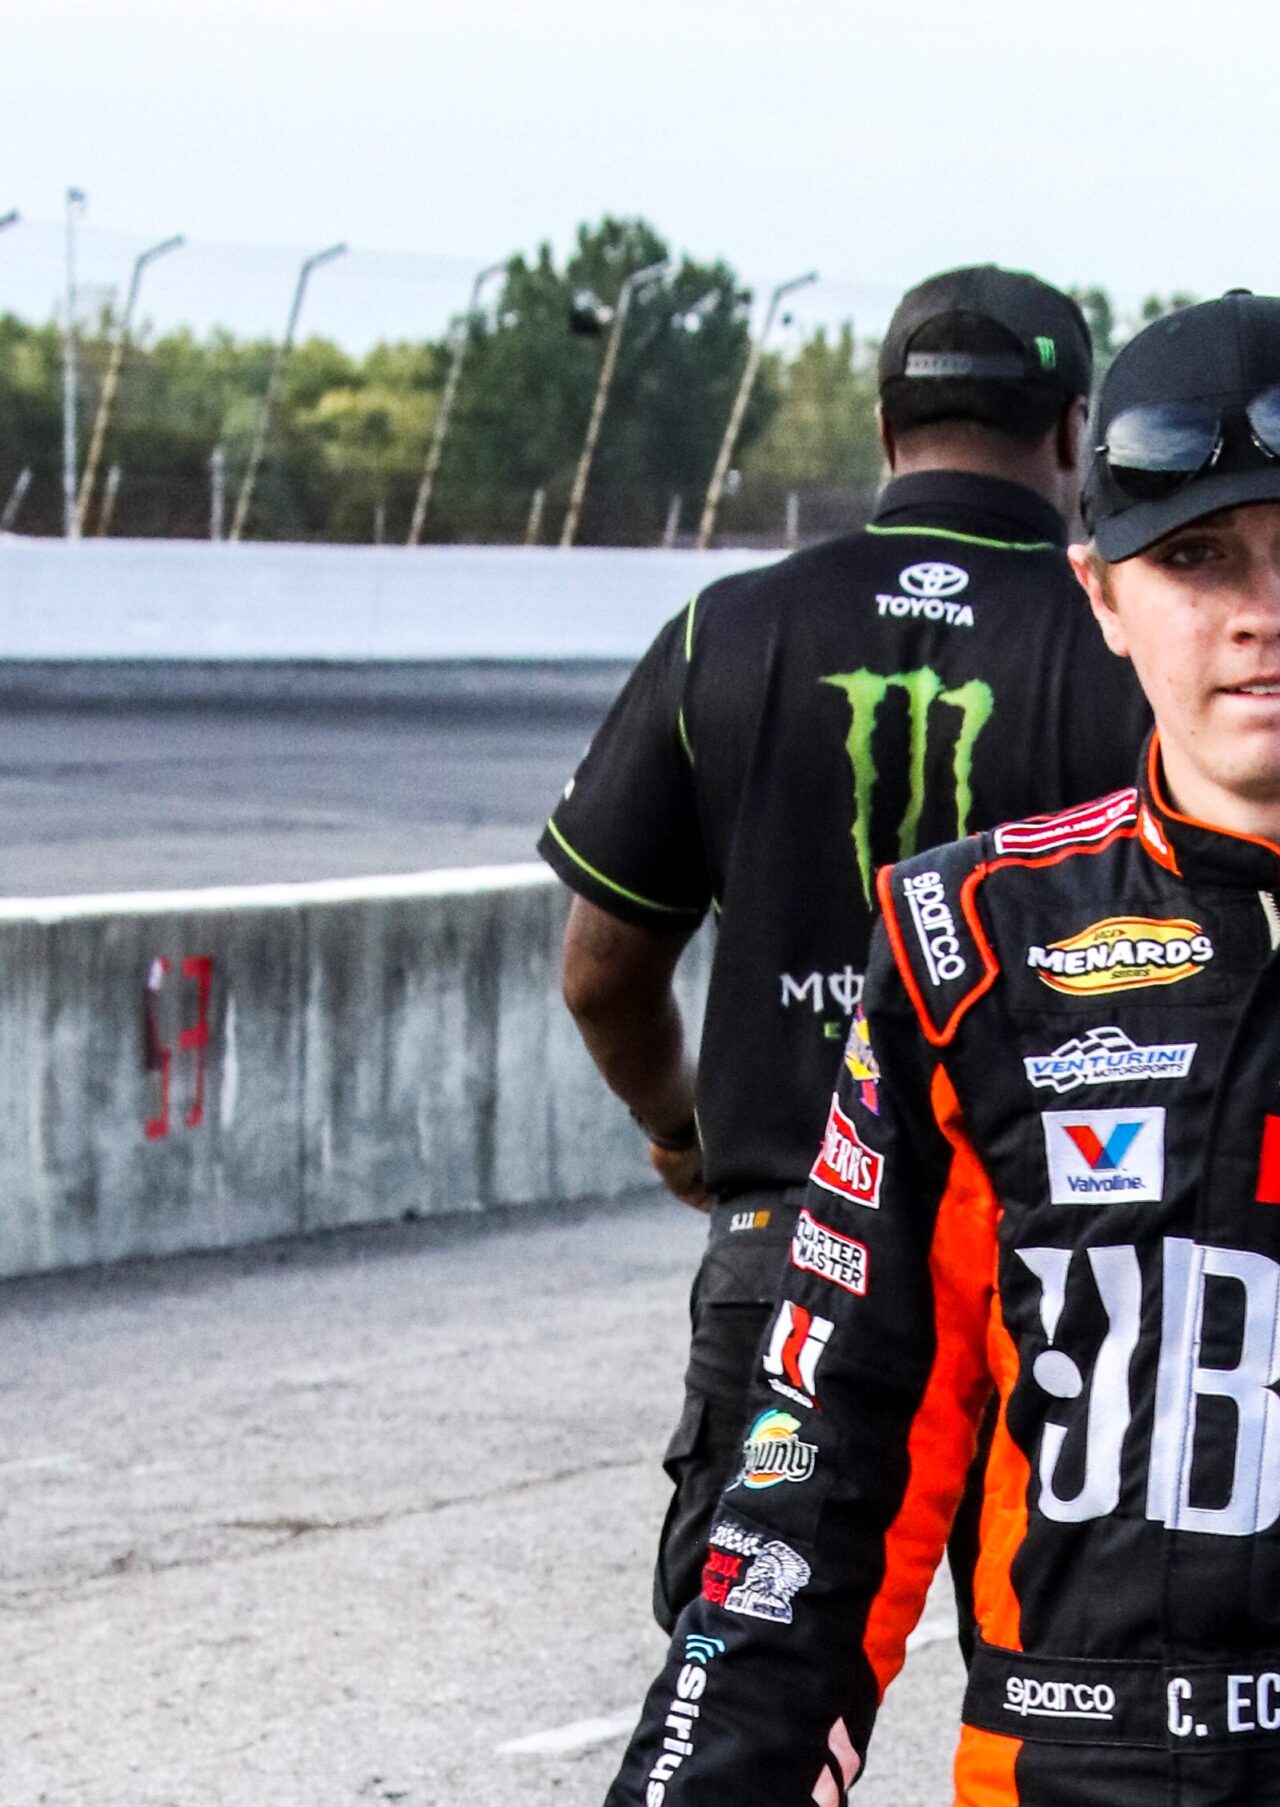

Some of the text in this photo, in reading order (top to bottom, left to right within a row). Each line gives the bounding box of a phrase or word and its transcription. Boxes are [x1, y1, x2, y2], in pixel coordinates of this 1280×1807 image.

[876, 594, 974, 626] TOYOTA
[904, 871, 967, 984] sparco
[1027, 935, 1214, 976] MENARDS
[1033, 1049, 1187, 1073] VENTURINI
[1067, 1175, 1143, 1193] Valvoline
[1005, 1675, 1116, 1716] sparco
[1167, 1677, 1208, 1737] C.
